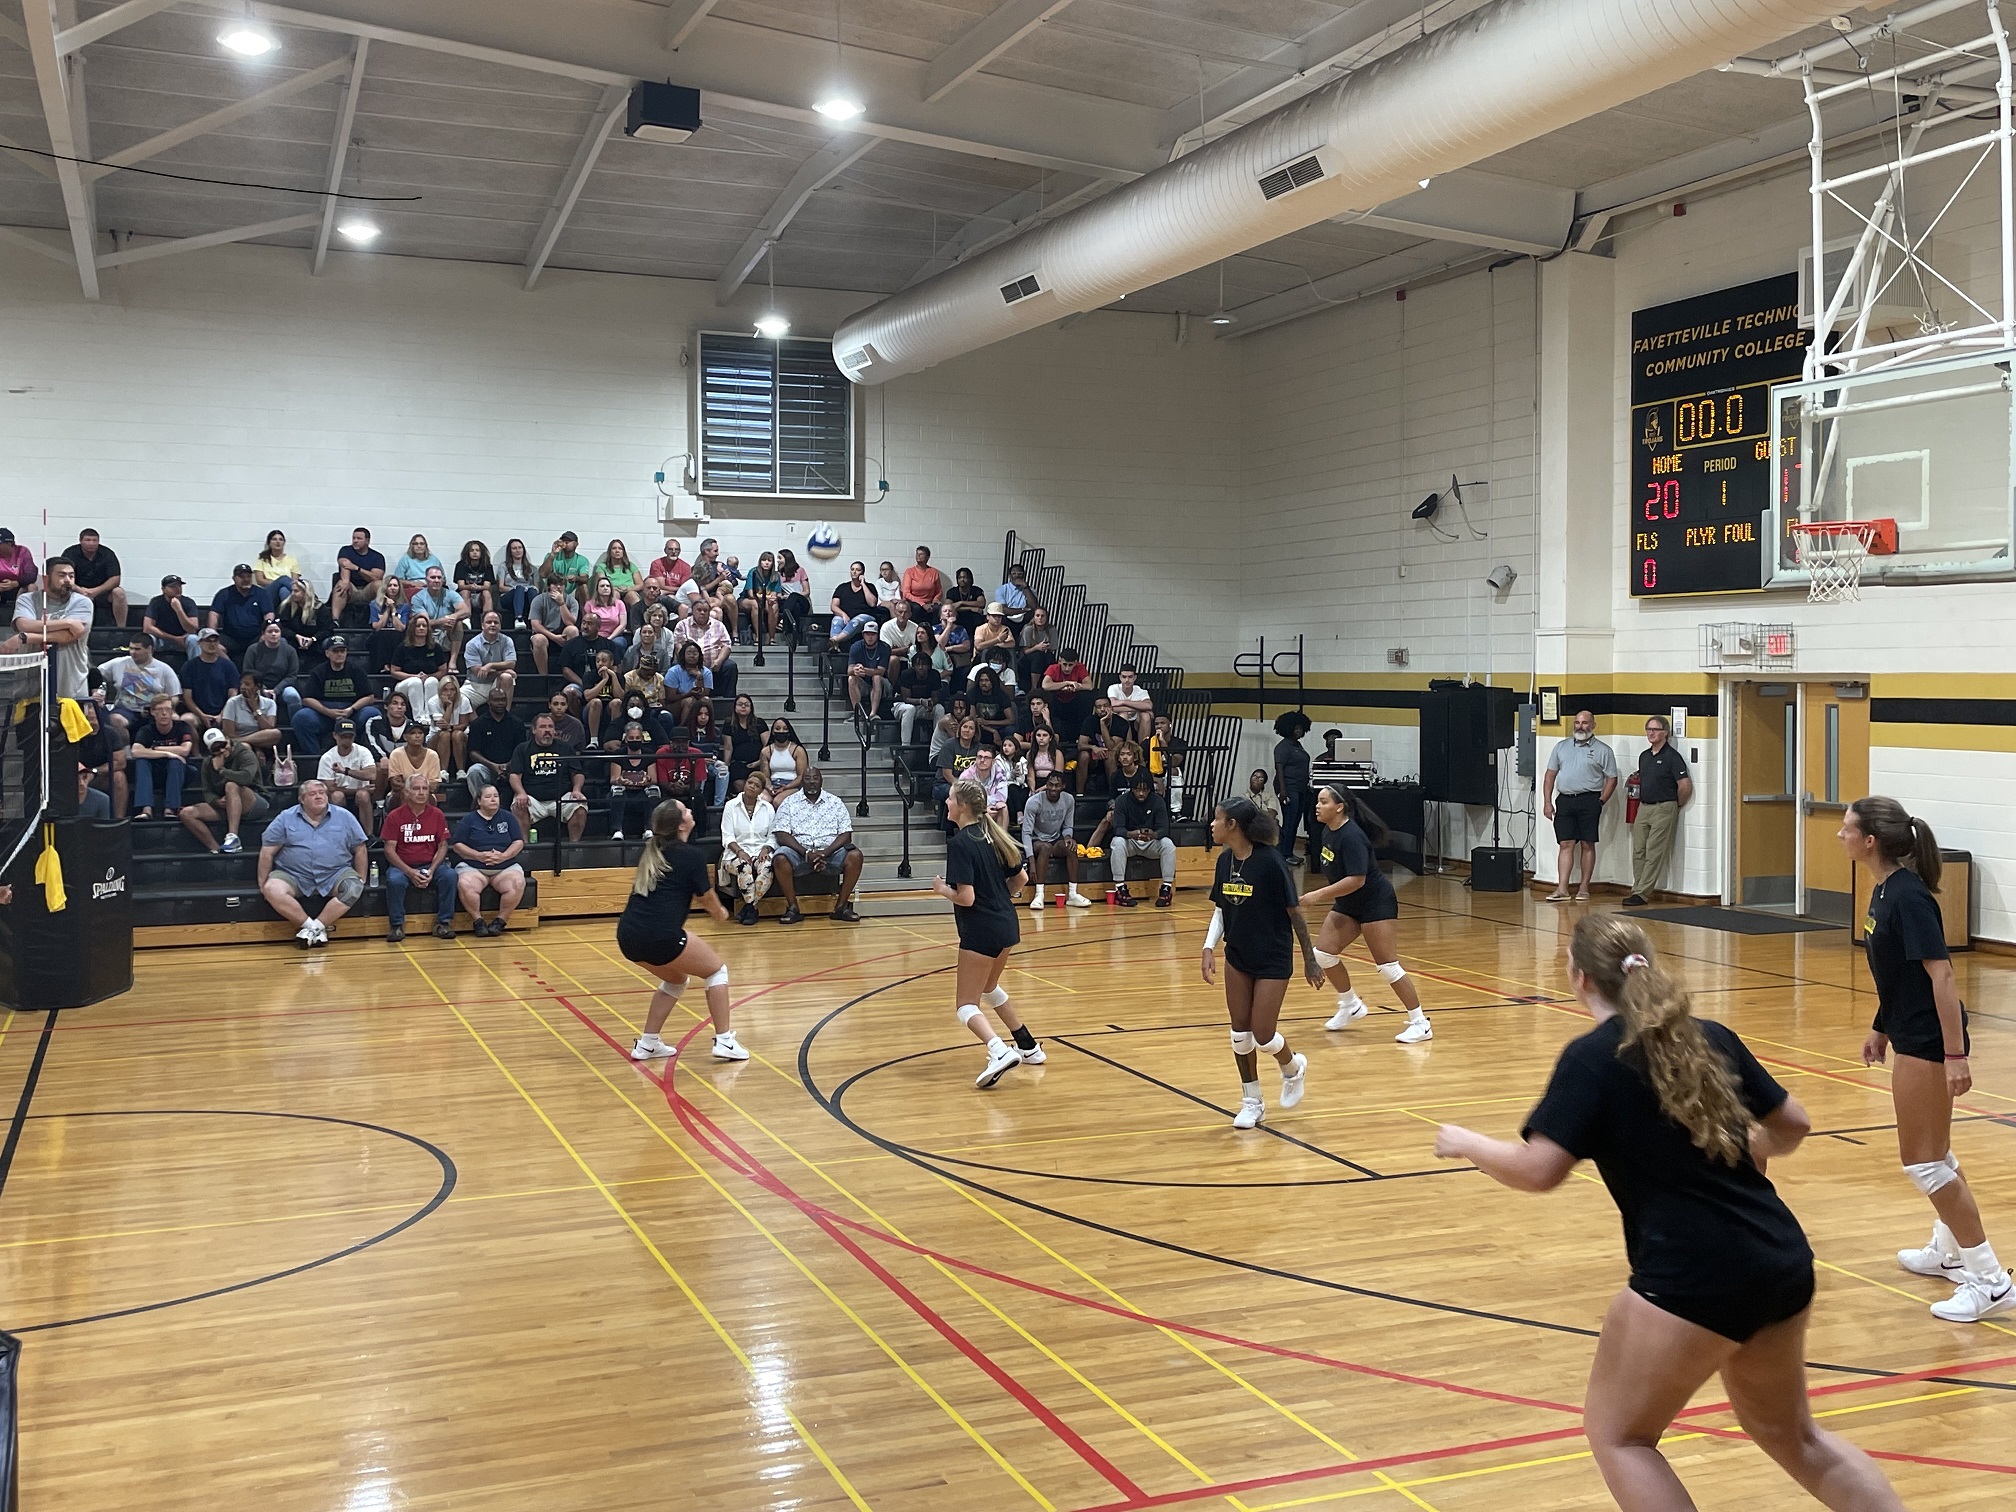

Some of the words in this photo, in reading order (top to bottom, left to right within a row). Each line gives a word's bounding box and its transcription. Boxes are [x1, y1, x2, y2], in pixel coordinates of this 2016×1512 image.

[1633, 319, 1732, 354] FAYETTEVILLE
[1646, 347, 1730, 377] COMMUNITY
[1734, 331, 1806, 360] COLLEGE
[1755, 437, 1797, 461] GUST
[1652, 454, 1683, 475] HOME
[1704, 457, 1737, 473] PERIOD
[1645, 480, 1680, 521] 20
[1636, 532, 1659, 551] FLS
[1686, 526, 1717, 547] PLYR
[1724, 523, 1756, 544] FOUL
[1643, 558, 1657, 588] 0
[404, 835, 435, 843] EXAMPLE
[92, 875, 125, 899] SPALDING
